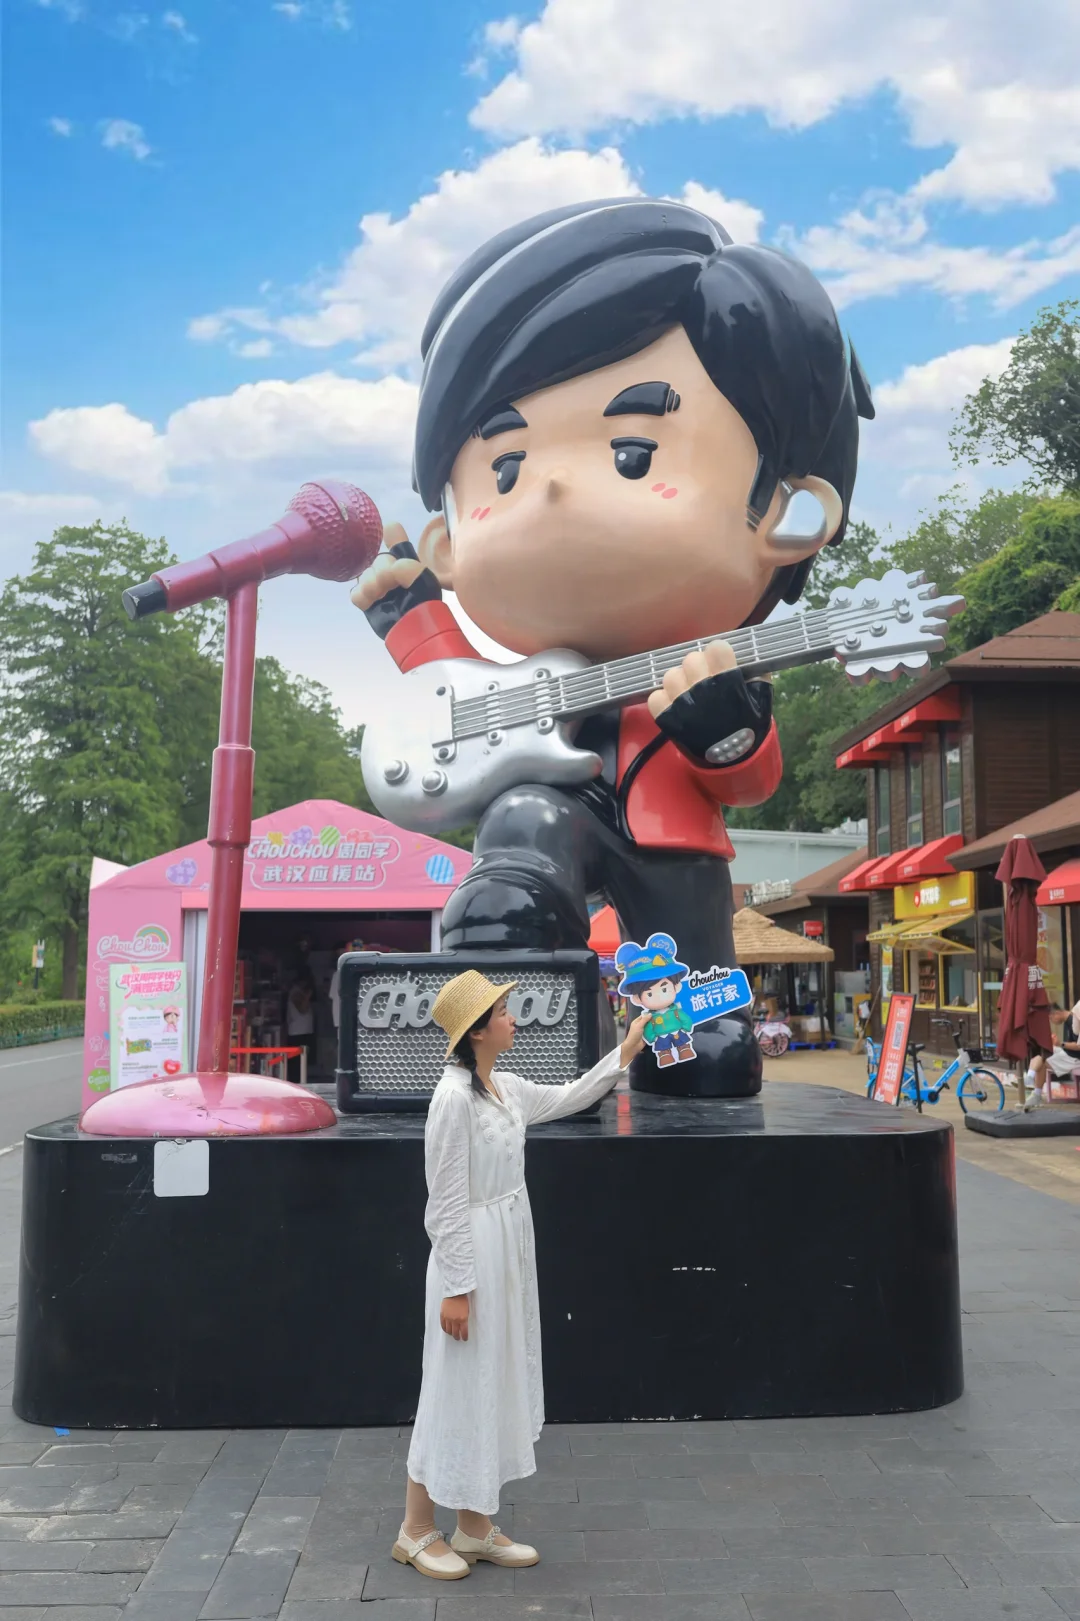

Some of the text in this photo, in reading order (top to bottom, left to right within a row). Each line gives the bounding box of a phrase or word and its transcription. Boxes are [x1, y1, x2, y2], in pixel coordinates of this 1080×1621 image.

[248, 841, 390, 859] CHOUCHOU 周同学
[262, 865, 376, 883] 武汉应援站
[690, 984, 740, 1012] 旅行家
